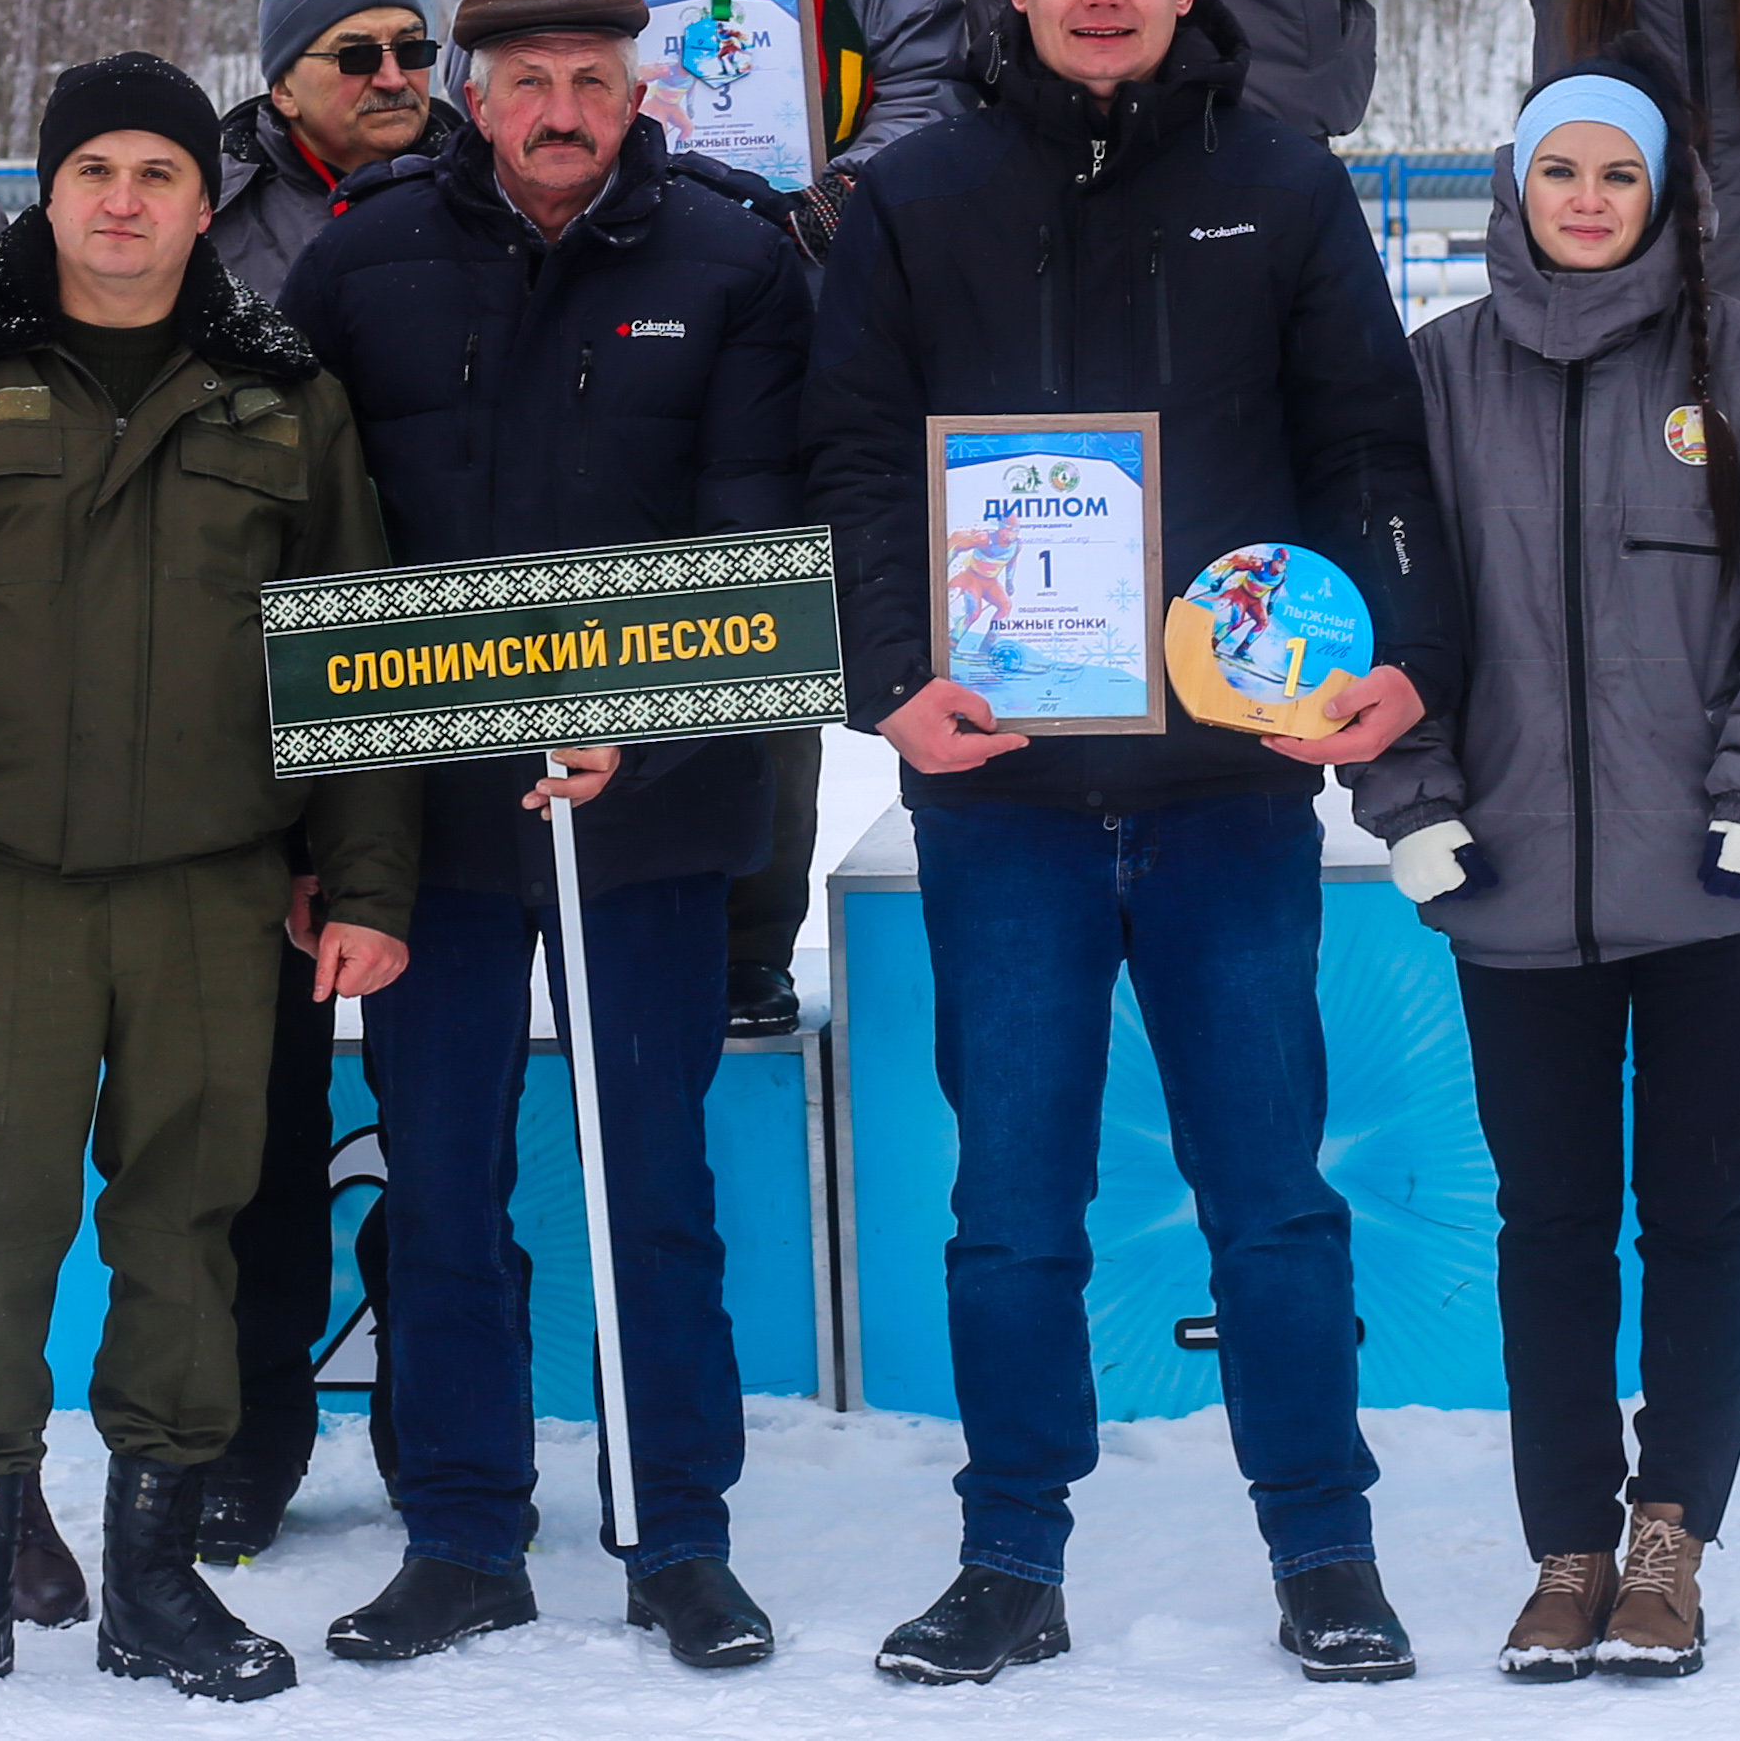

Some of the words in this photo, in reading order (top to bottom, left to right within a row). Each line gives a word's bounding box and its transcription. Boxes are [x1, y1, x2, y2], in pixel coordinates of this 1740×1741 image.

[712, 83, 732, 112] 3
[675, 138, 731, 150] ЛЫЖНЫЕ
[734, 135, 775, 146] ГОНКИ
[1207, 223, 1256, 238] Columbia
[631, 319, 686, 332] Columbia
[983, 497, 1108, 521] ДИПЛОМ
[1392, 529, 1413, 576] Columbia
[1038, 550, 1052, 588] 1
[989, 619, 1055, 631] ЛЫЖНЫЕ
[1058, 618, 1107, 630] ГОНКИ
[1282, 605, 1357, 630] ЛЫЖНЫЕ
[1299, 622, 1355, 644] ГОНКИ
[327, 618, 607, 695] СЛОНИМСКИЙ
[618, 612, 779, 666] ЛЕСХОЗ
[1283, 637, 1308, 698] 1
